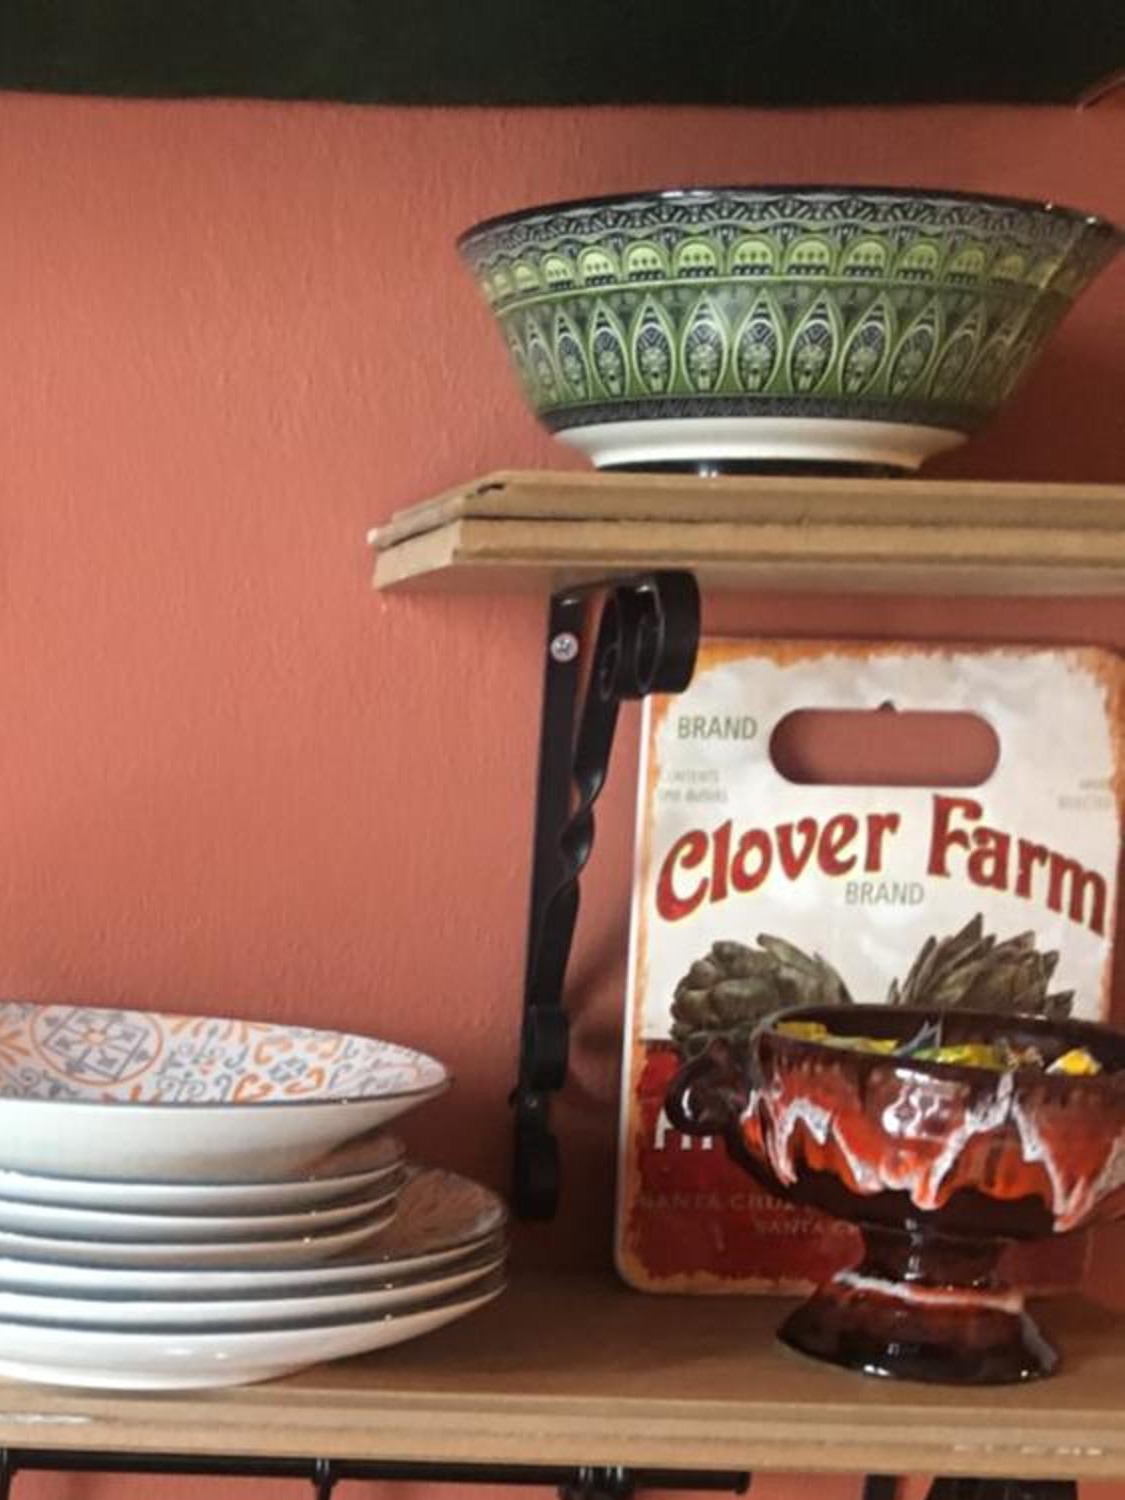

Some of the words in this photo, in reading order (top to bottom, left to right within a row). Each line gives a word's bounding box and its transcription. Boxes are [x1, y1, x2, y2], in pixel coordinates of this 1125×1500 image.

[676, 715, 758, 741] BRAND
[655, 811, 900, 922] Clover
[927, 795, 1108, 938] Farm
[844, 881, 924, 906] BRAND
